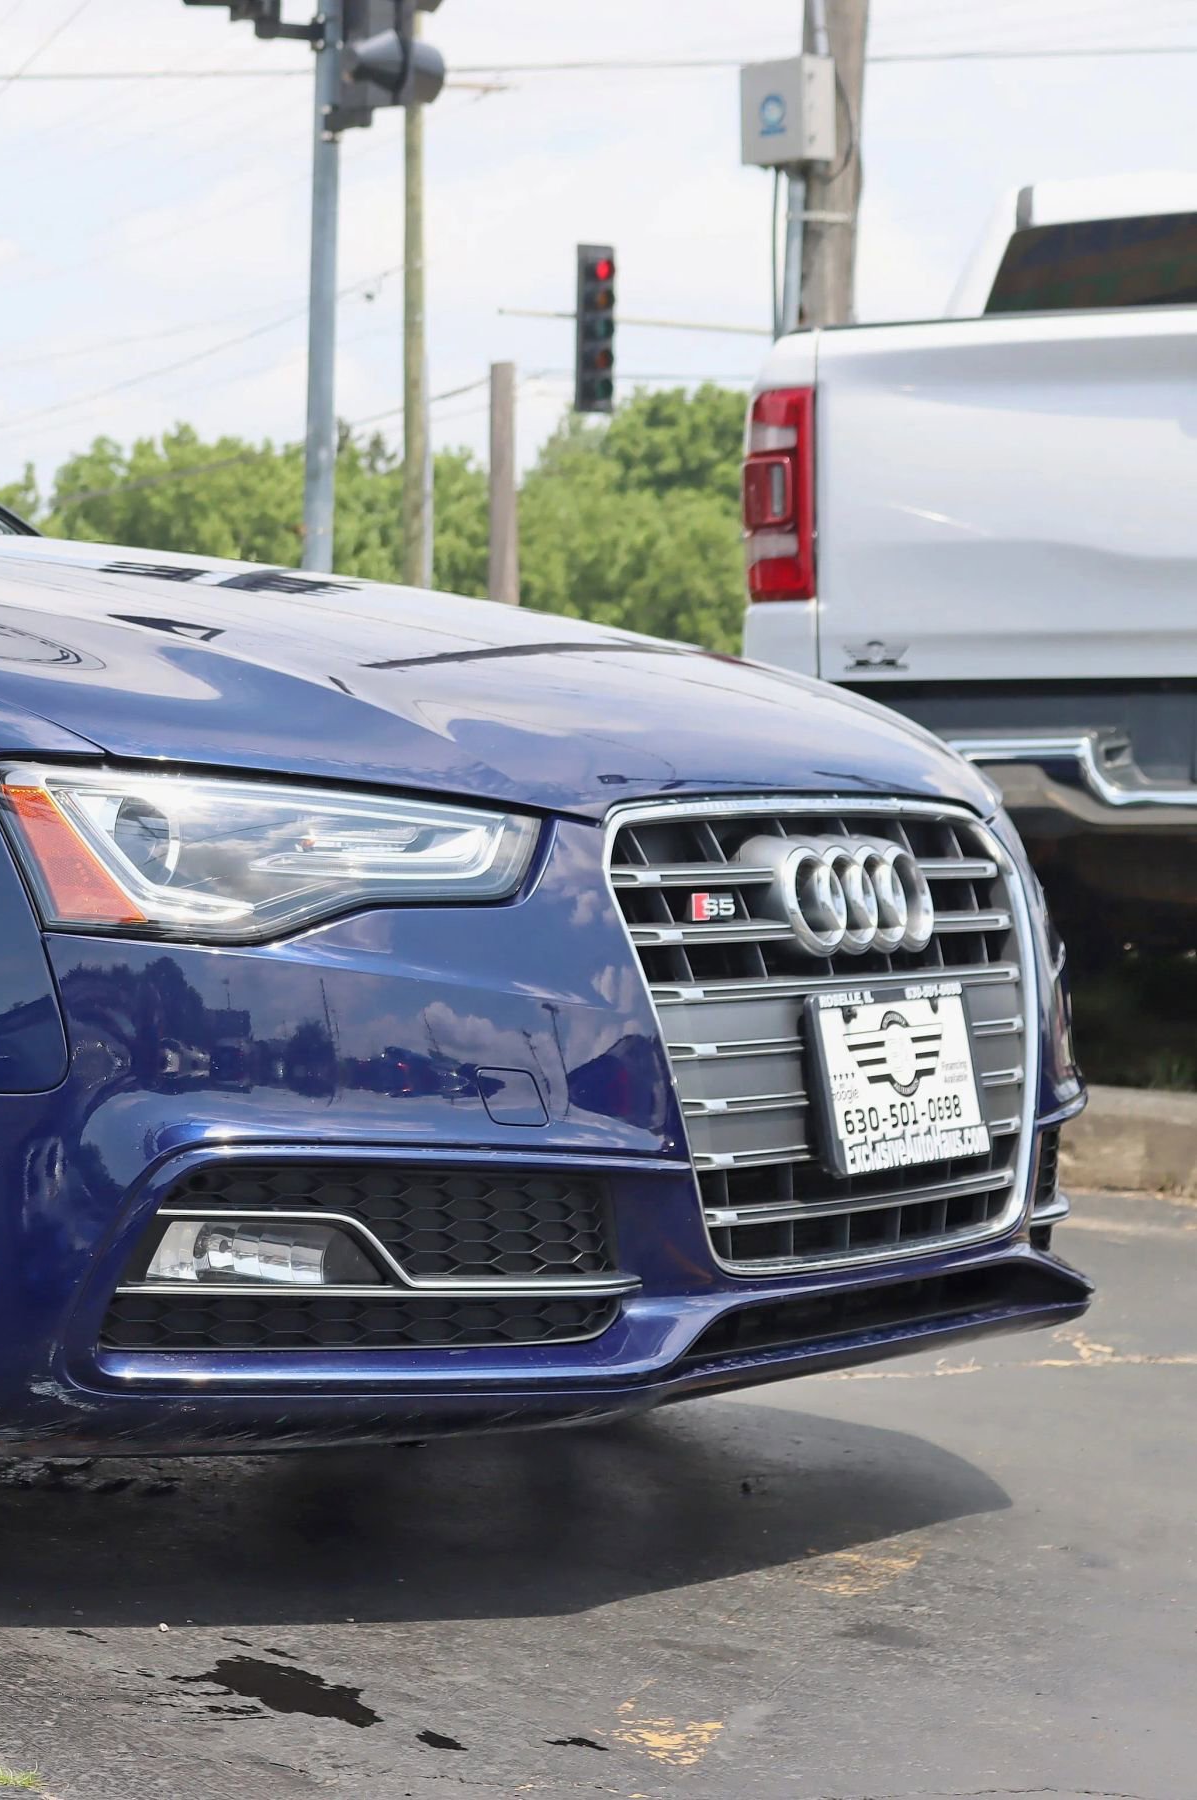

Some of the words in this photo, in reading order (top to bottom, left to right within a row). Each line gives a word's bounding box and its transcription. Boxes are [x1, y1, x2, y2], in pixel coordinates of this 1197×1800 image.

[700, 897, 735, 917] S5
[844, 1094, 962, 1135] 630-501-0698
[844, 1125, 991, 1175] ExclusiveAutoHaus.com
